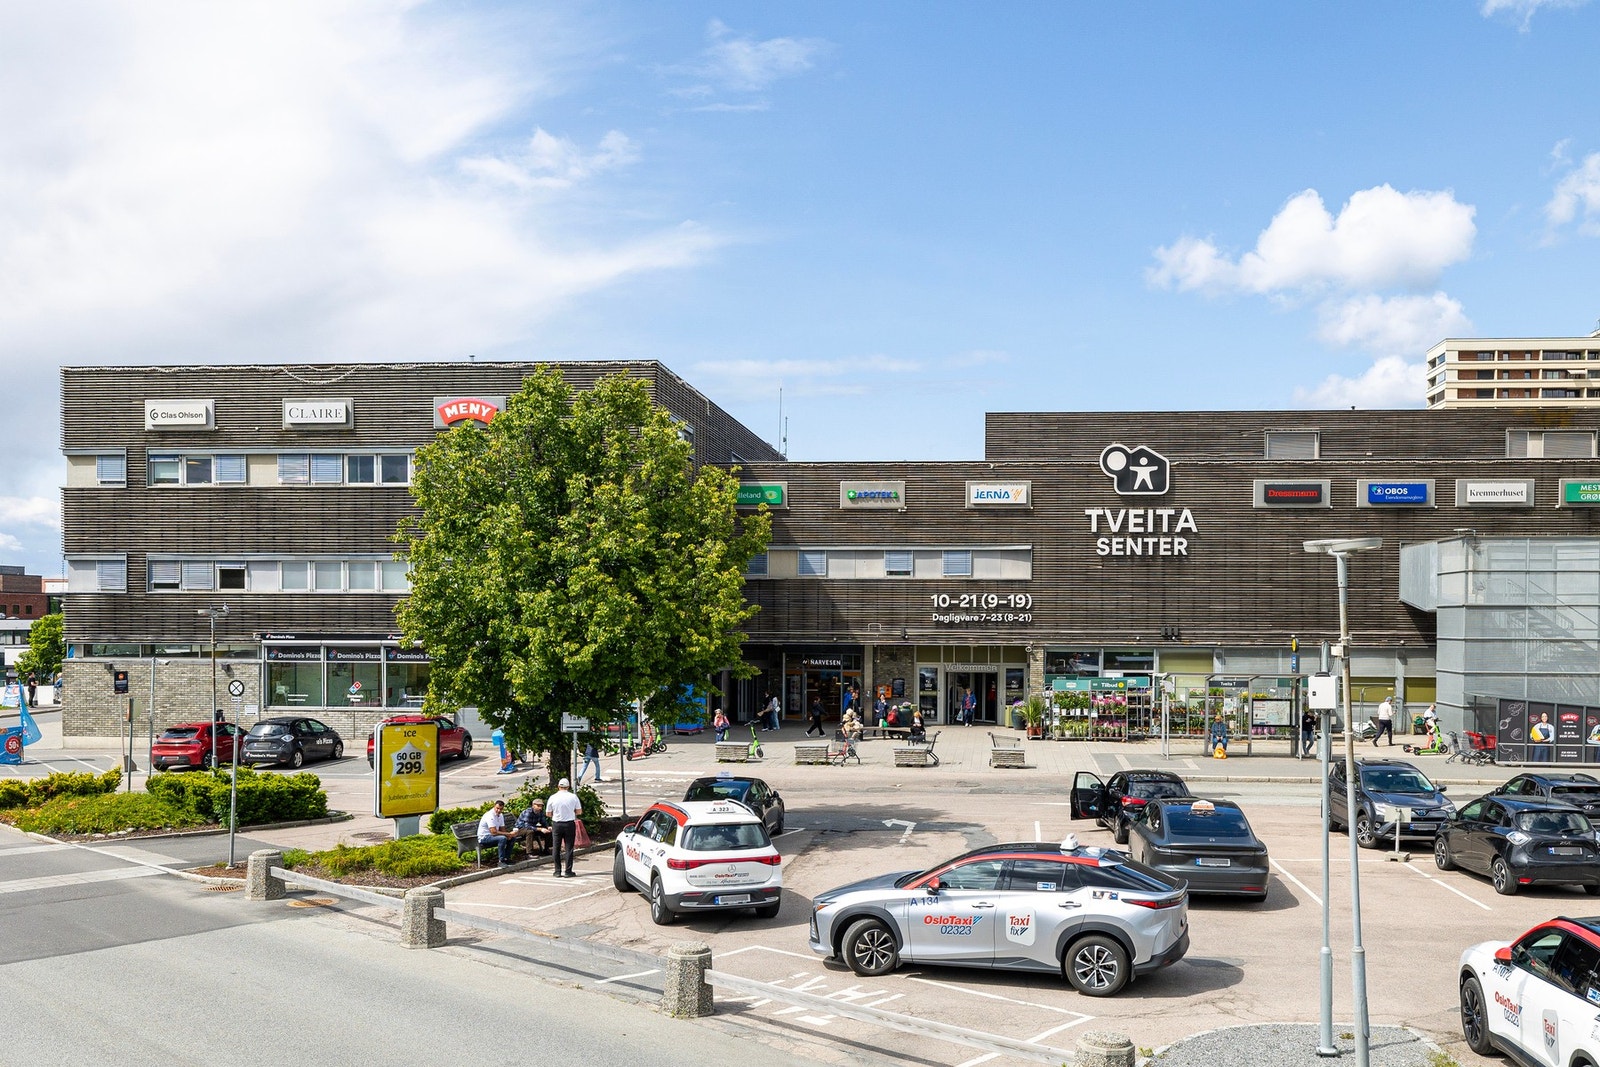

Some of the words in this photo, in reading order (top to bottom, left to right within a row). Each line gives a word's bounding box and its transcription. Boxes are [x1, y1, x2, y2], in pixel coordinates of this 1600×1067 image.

[178, 411, 204, 419] Ohlson
[289, 407, 343, 419] CLAIRE
[444, 402, 492, 418] MENY
[857, 490, 892, 498] APOTEK
[1268, 489, 1317, 497] Dressmann
[1085, 508, 1198, 533] TVEITA
[1096, 537, 1188, 556] SENTER
[932, 613, 979, 623] Dagligvare
[945, 663, 998, 671] Velkommen
[396, 752, 408, 761] 60
[409, 752, 422, 760] GB
[910, 897, 918, 906] A
[920, 896, 939, 906] 134
[923, 915, 973, 926] OsloTaxi
[1009, 914, 1030, 926] Taxi
[940, 925, 972, 935] 02323
[1010, 926, 1020, 936] fix
[1494, 991, 1519, 1015] OsloTaxi
[1544, 1018, 1556, 1036] Taxi
